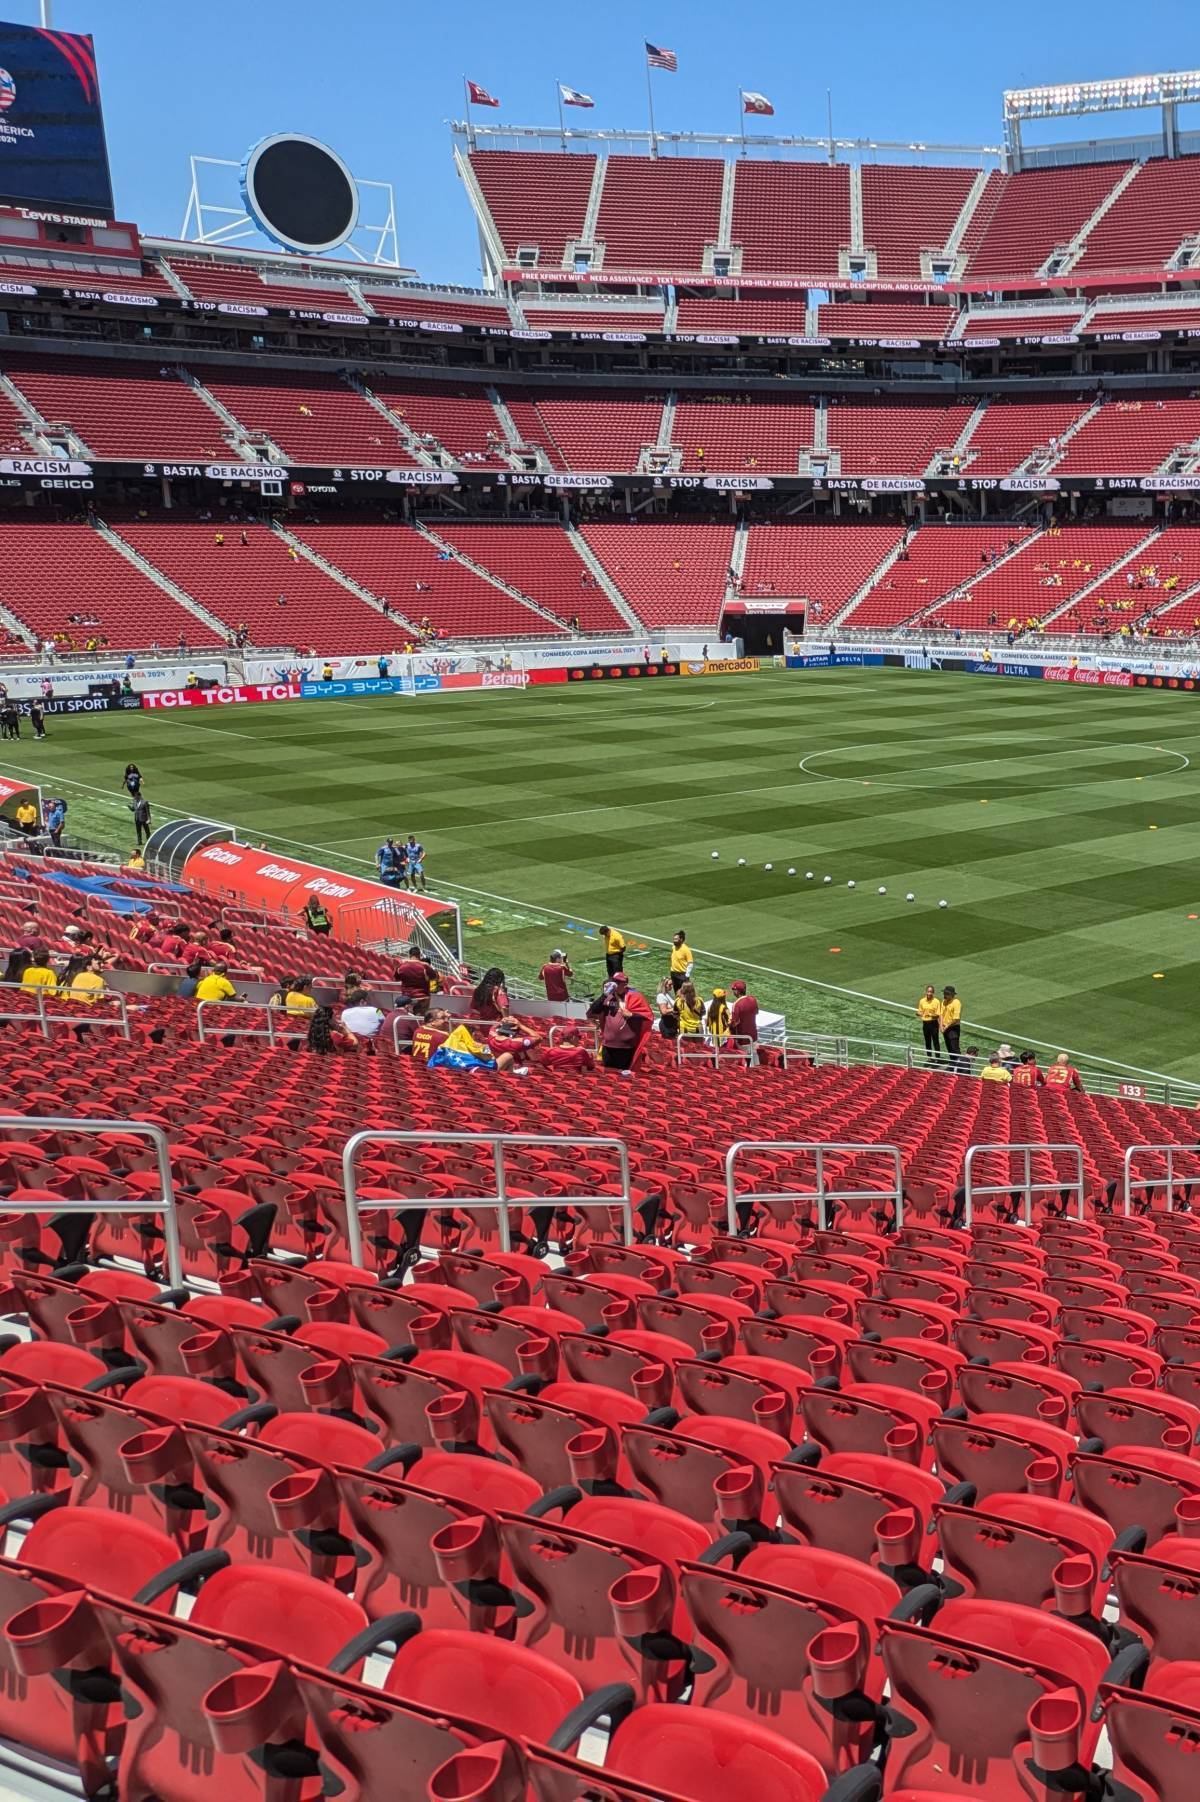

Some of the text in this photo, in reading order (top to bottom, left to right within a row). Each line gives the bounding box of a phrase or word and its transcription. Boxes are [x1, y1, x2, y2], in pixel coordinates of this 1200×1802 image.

[63, 214, 108, 229] STADIUM
[521, 272, 539, 281] FREE
[540, 273, 568, 282] XFINITY
[590, 275, 652, 284] NEED ASSISTANCE?
[657, 277, 673, 285] TEXT
[674, 277, 713, 285] "SUPPORT"
[714, 278, 722, 286] TO
[800, 281, 828, 289] INCLUDE
[895, 283, 909, 291] AND
[910, 284, 945, 292] LOCATION.
[75, 291, 155, 305] BASTA DE RACISMO
[193, 302, 258, 314] STOP RACISM
[299, 311, 367, 324] BASTA DE RACISMO
[398, 319, 454, 332] STOP RACISM
[13, 461, 71, 474] RACISM
[163, 466, 282, 479] BASTA DE RACISMO
[350, 470, 443, 483] STOP RACISM
[512, 475, 608, 487] BASTA DE RACISMO
[1109, 478, 1200, 488] BASTA DE RACISMO
[41, 479, 95, 489] GEICO
[307, 485, 337, 493] TOYOTA
[670, 478, 758, 489] STOP RACISM
[828, 480, 921, 490] BASTA DE RACISMO
[971, 480, 1047, 490] STOP RACISM
[841, 655, 861, 663] DELTA
[904, 655, 932, 670] PUMA
[708, 659, 753, 673] mercado
[1004, 665, 1029, 676] ULTRA
[73, 674, 96, 682] COPA
[96, 673, 130, 681] AMERICA
[132, 671, 147, 679] USA
[147, 671, 166, 679] 2024
[481, 673, 530, 686] Betano
[257, 683, 301, 702] TCL
[304, 684, 347, 696] BYD
[352, 681, 394, 692] BYD
[144, 690, 192, 708] TCL
[201, 687, 248, 704] TCL
[68, 698, 110, 712] SPORT
[201, 847, 243, 866] Betano
[255, 863, 302, 883] Betano
[304, 877, 355, 899] Betano
[1122, 1085, 1141, 1098] 133
